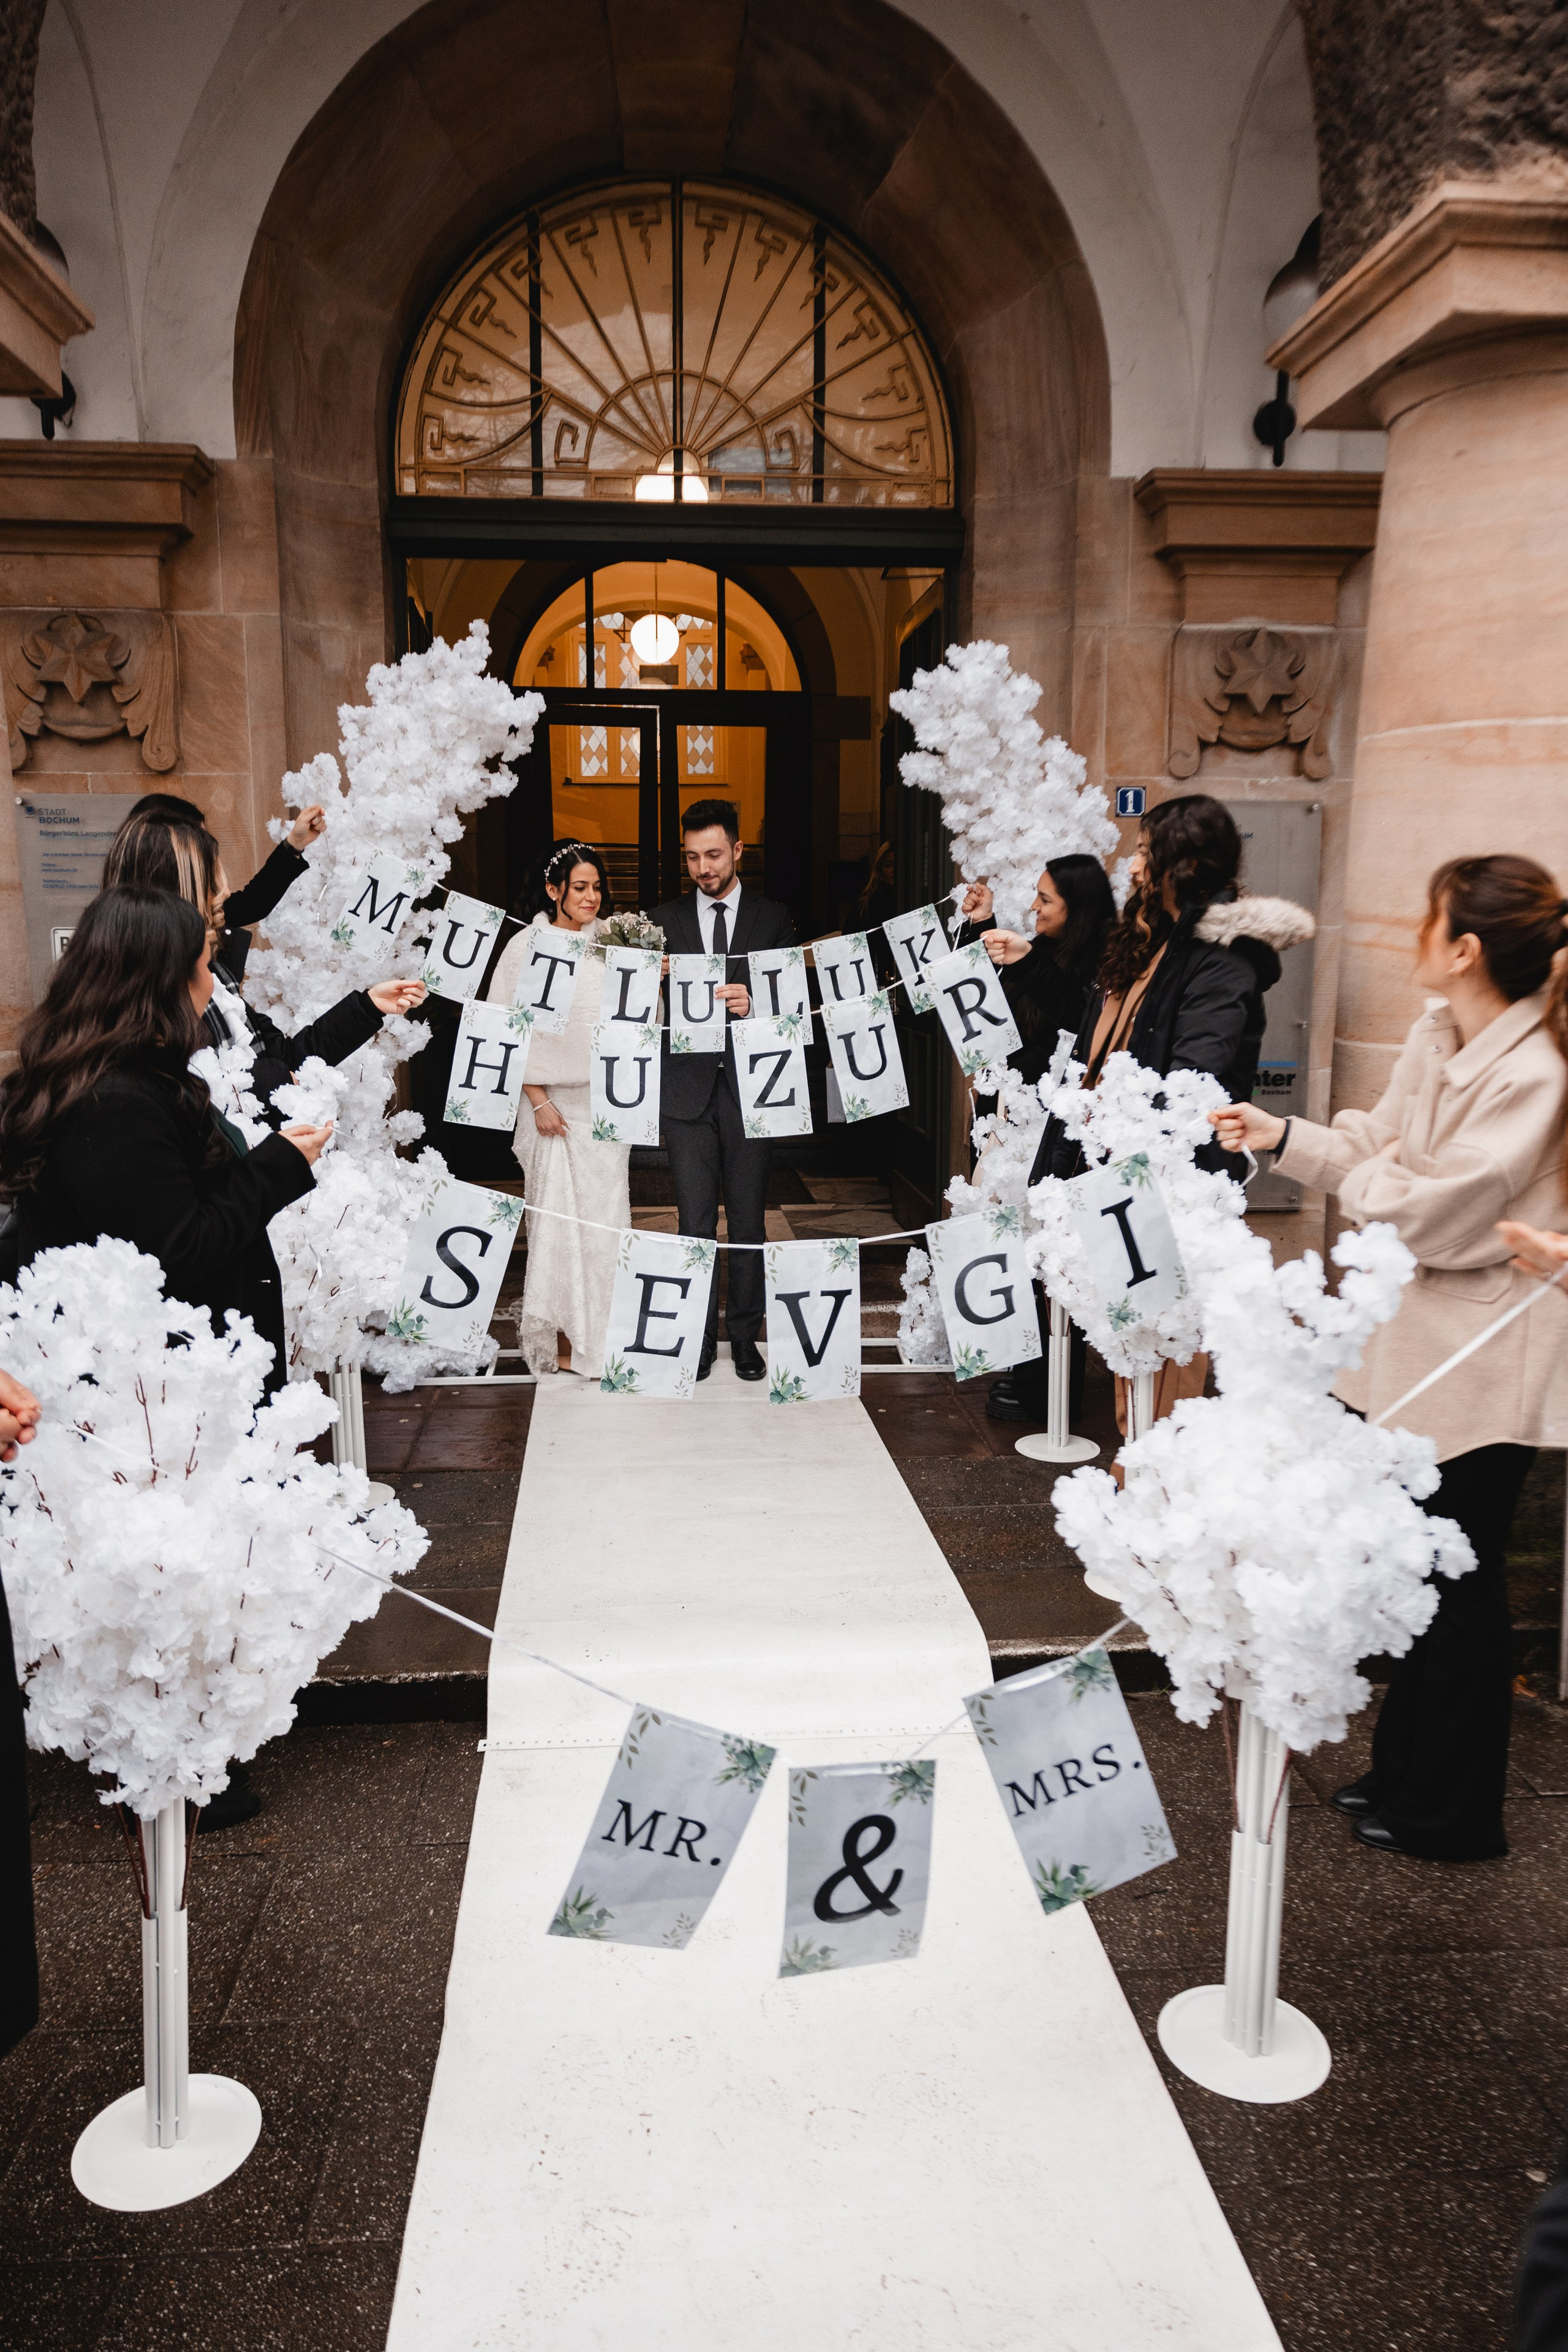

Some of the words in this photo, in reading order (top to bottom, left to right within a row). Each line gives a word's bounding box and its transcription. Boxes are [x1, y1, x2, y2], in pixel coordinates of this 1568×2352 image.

[1125, 790, 1135, 813] 1
[601, 1799, 722, 1867] MR.
[813, 1813, 904, 1924] &
[1003, 1743, 1143, 1818] MRS.
